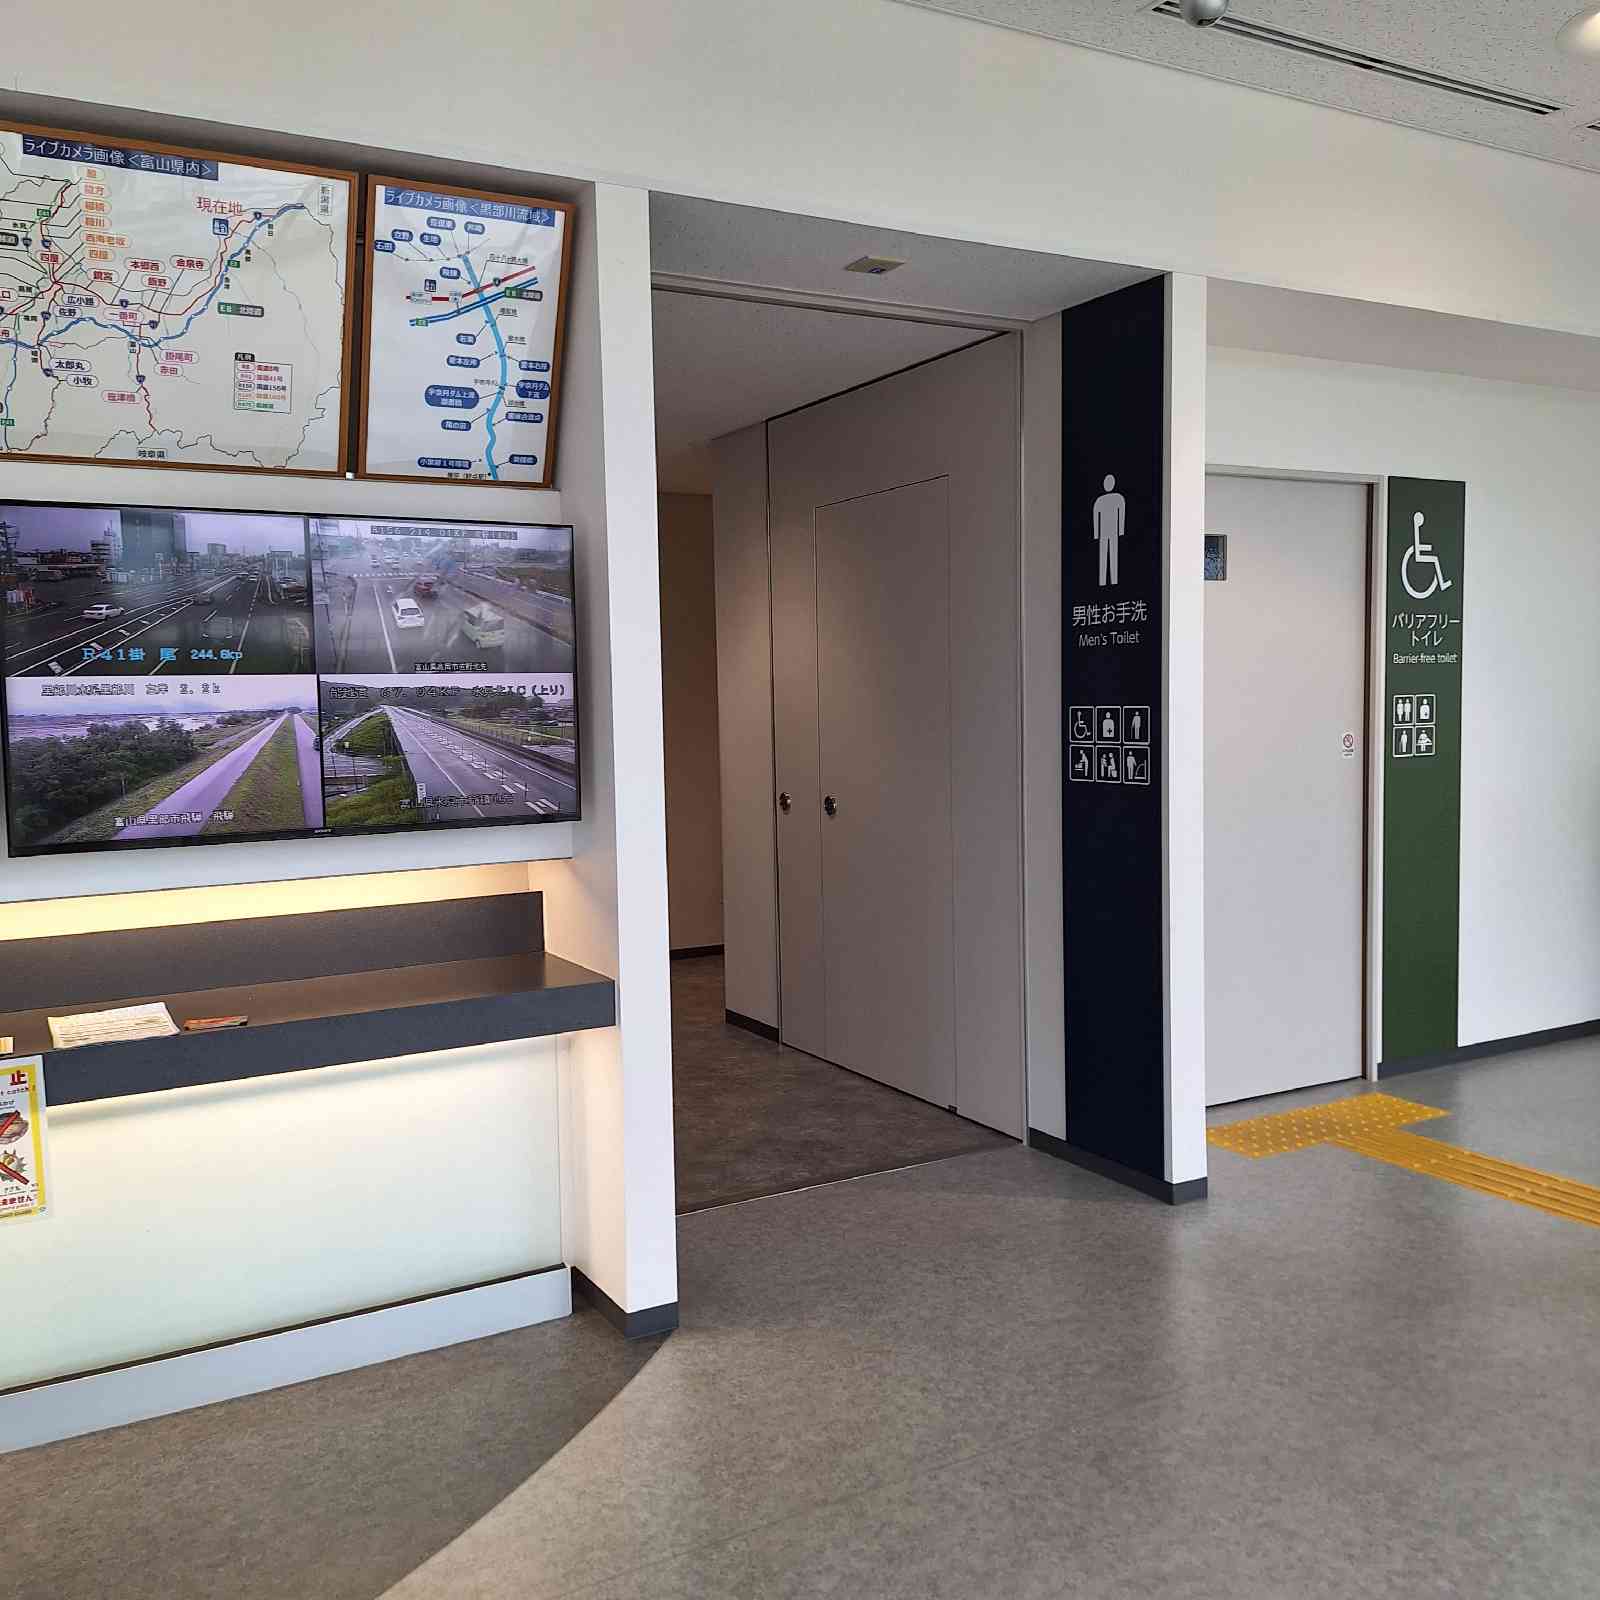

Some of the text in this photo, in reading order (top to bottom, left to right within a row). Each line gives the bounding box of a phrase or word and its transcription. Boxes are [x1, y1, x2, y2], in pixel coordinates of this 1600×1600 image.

[196, 197, 243, 217] 現在地
[55, 360, 85, 371] 太郎丸
[1072, 600, 1147, 626] 男性お手洗
[1392, 612, 1461, 629] バリアフリー
[1078, 630, 1140, 647] Men's Toilet
[1412, 630, 1443, 647] トイレ
[1393, 652, 1458, 664] Barrier-free toilet
